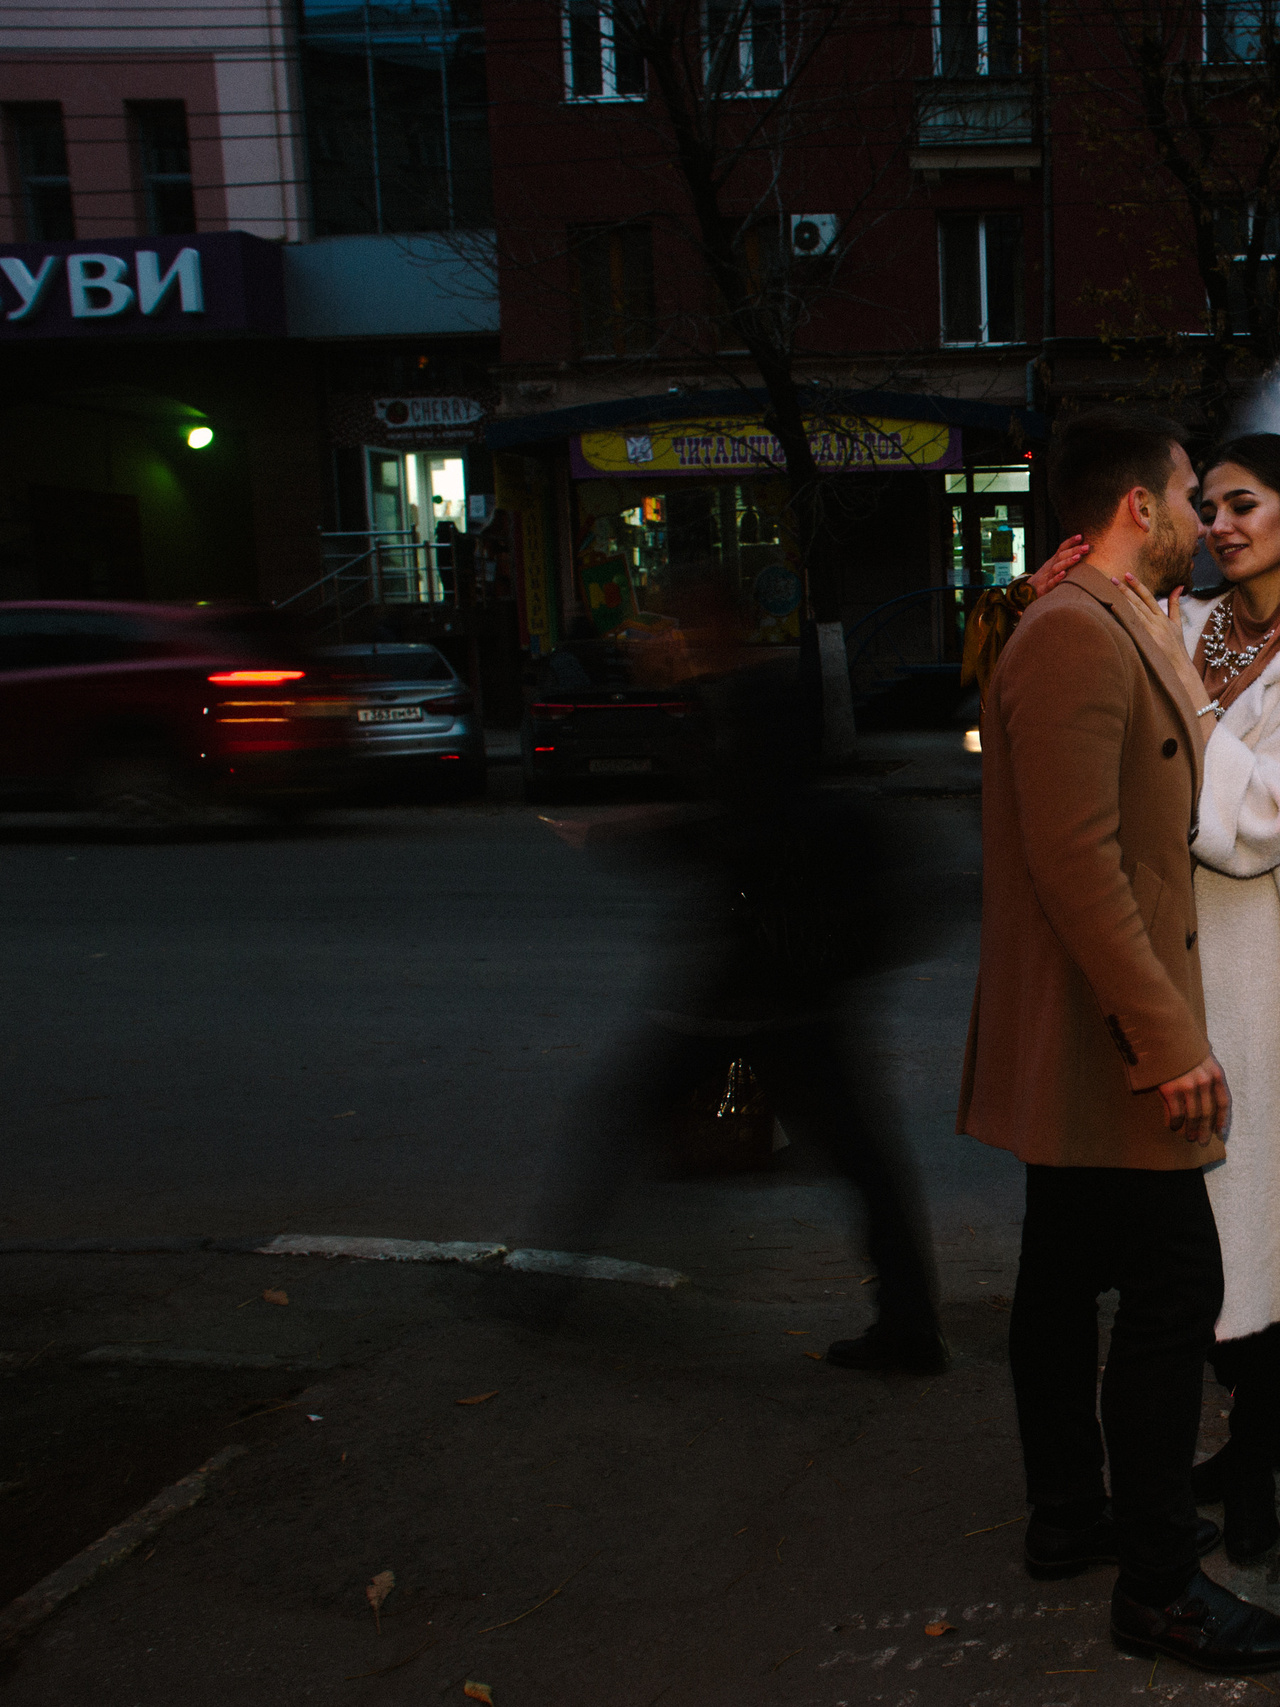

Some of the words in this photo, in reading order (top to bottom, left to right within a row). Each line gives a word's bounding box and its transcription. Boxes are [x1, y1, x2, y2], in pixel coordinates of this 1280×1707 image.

[0, 247, 204, 321] УВИ
[411, 400, 471, 422] CHERRY
[672, 435, 787, 464] ЧИТАЮЩИ
